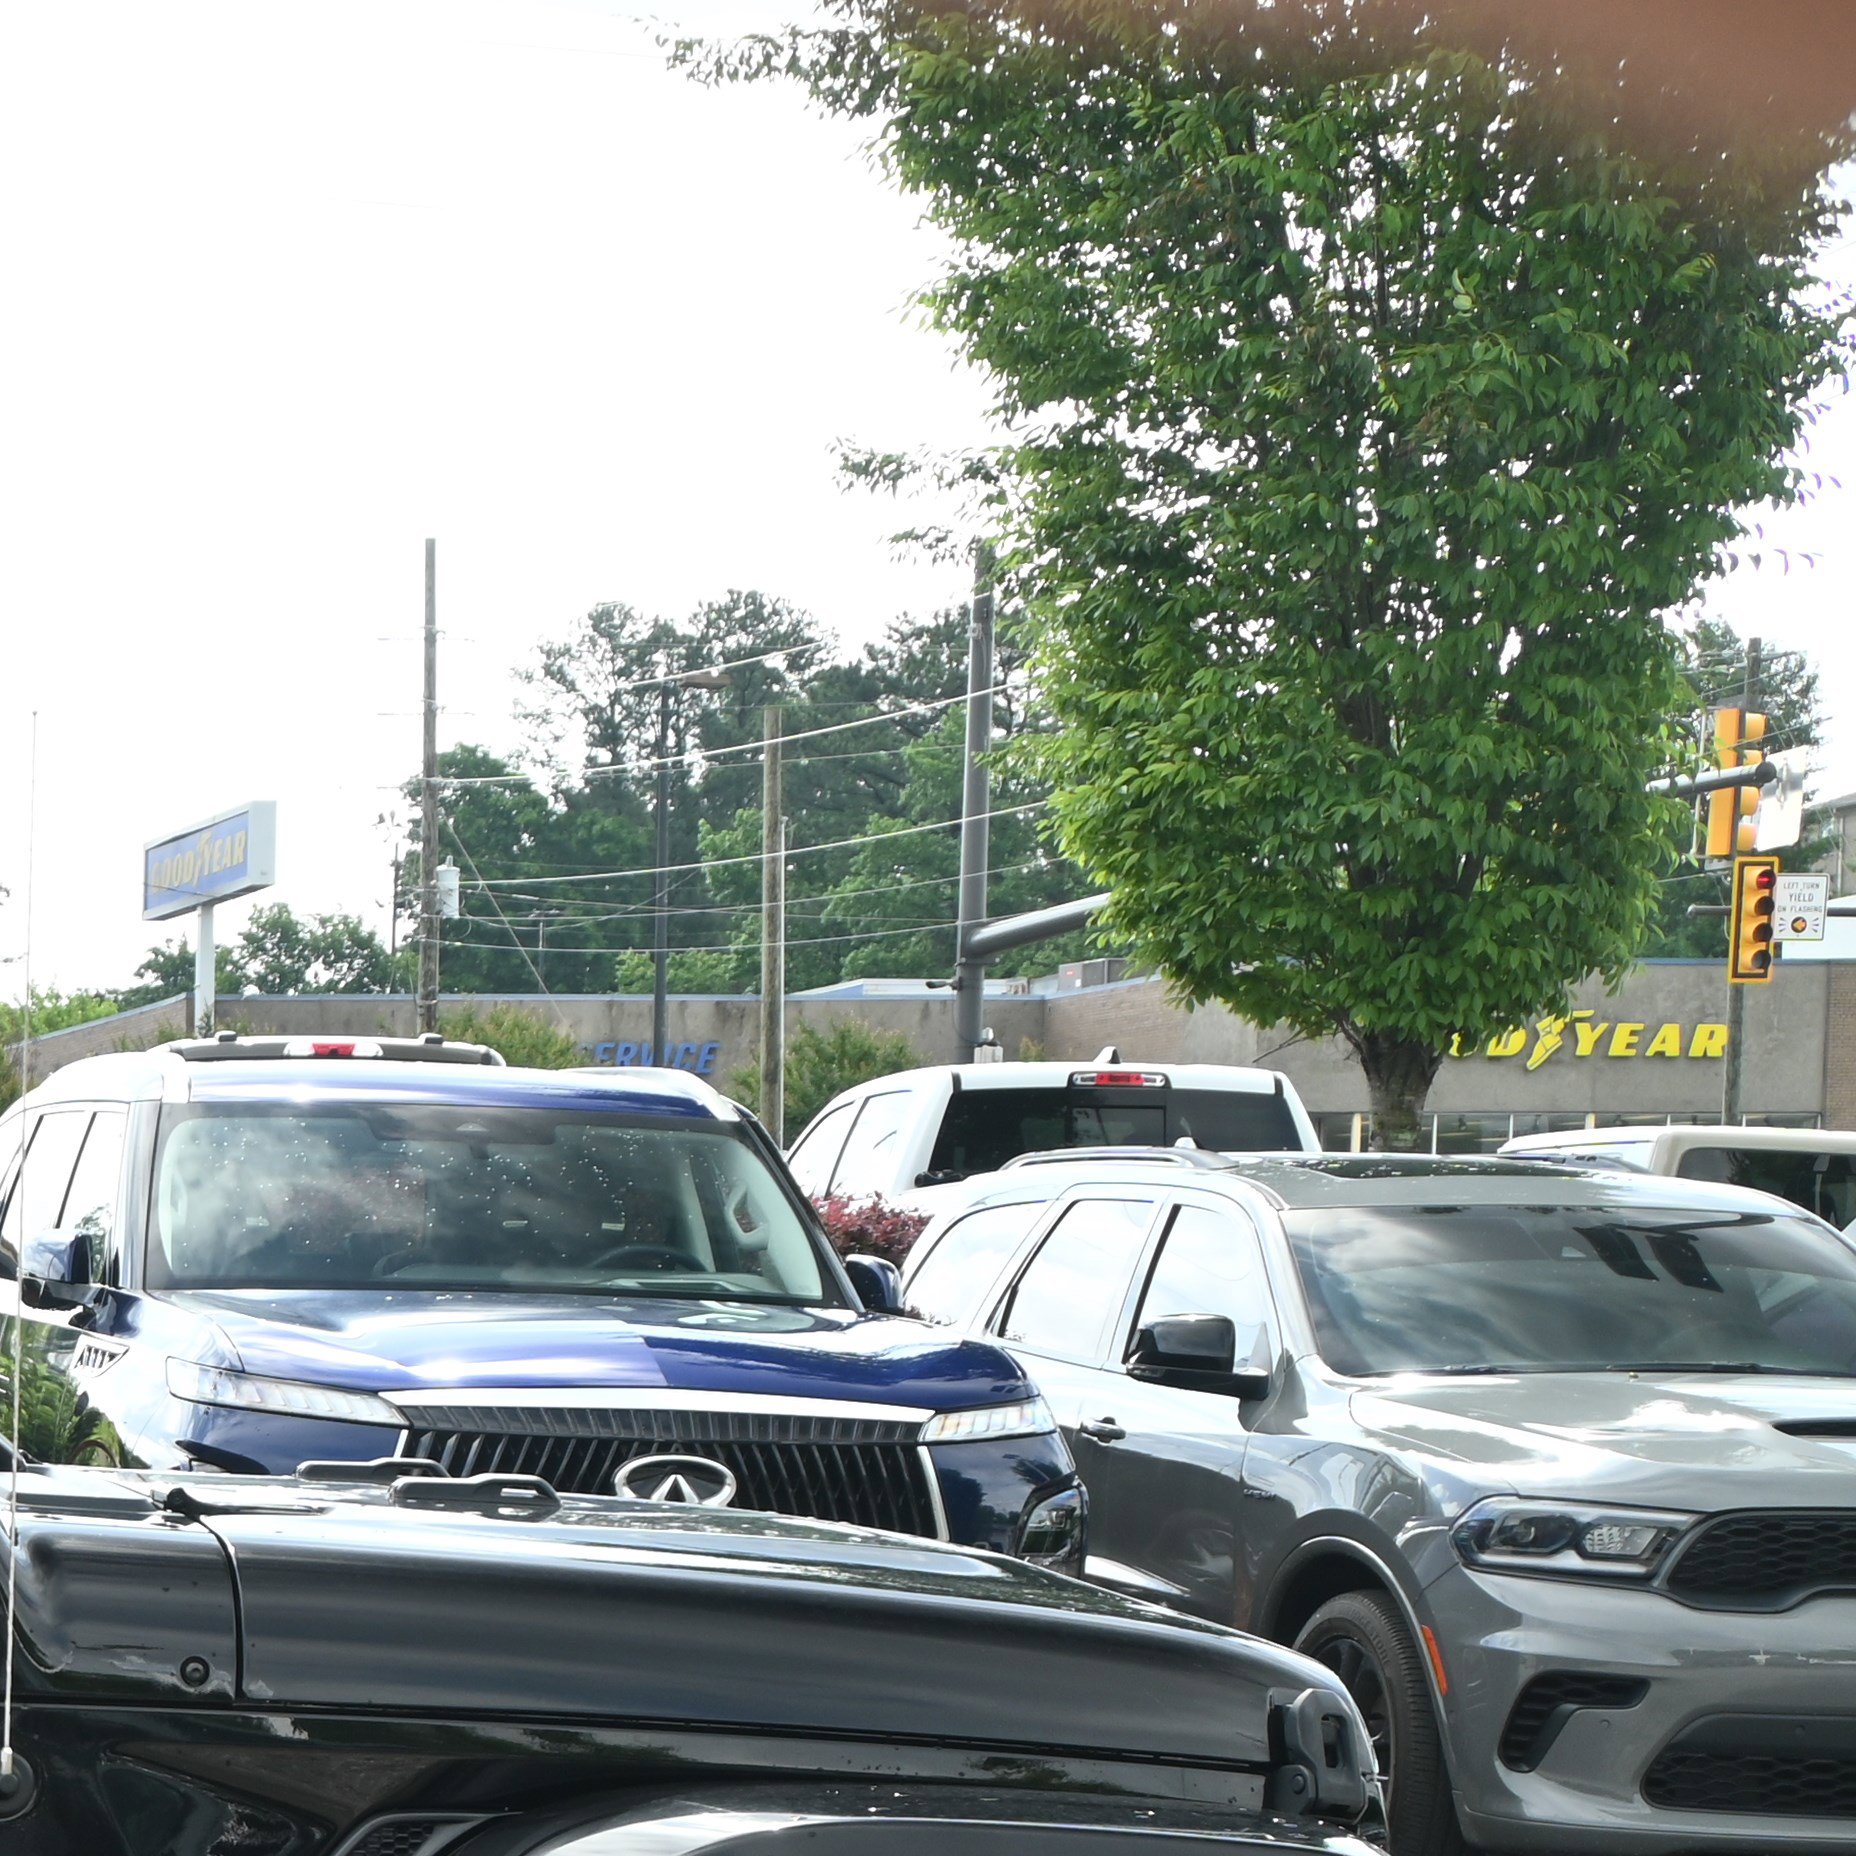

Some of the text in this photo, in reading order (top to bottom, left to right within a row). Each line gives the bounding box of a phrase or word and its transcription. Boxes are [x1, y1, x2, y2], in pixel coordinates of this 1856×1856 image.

[151, 831, 247, 896] GOODYEAR
[1783, 882, 1820, 890] LEFT TURN
[1789, 892, 1814, 902] YIELD
[1777, 905, 1823, 913] ON FLASHING
